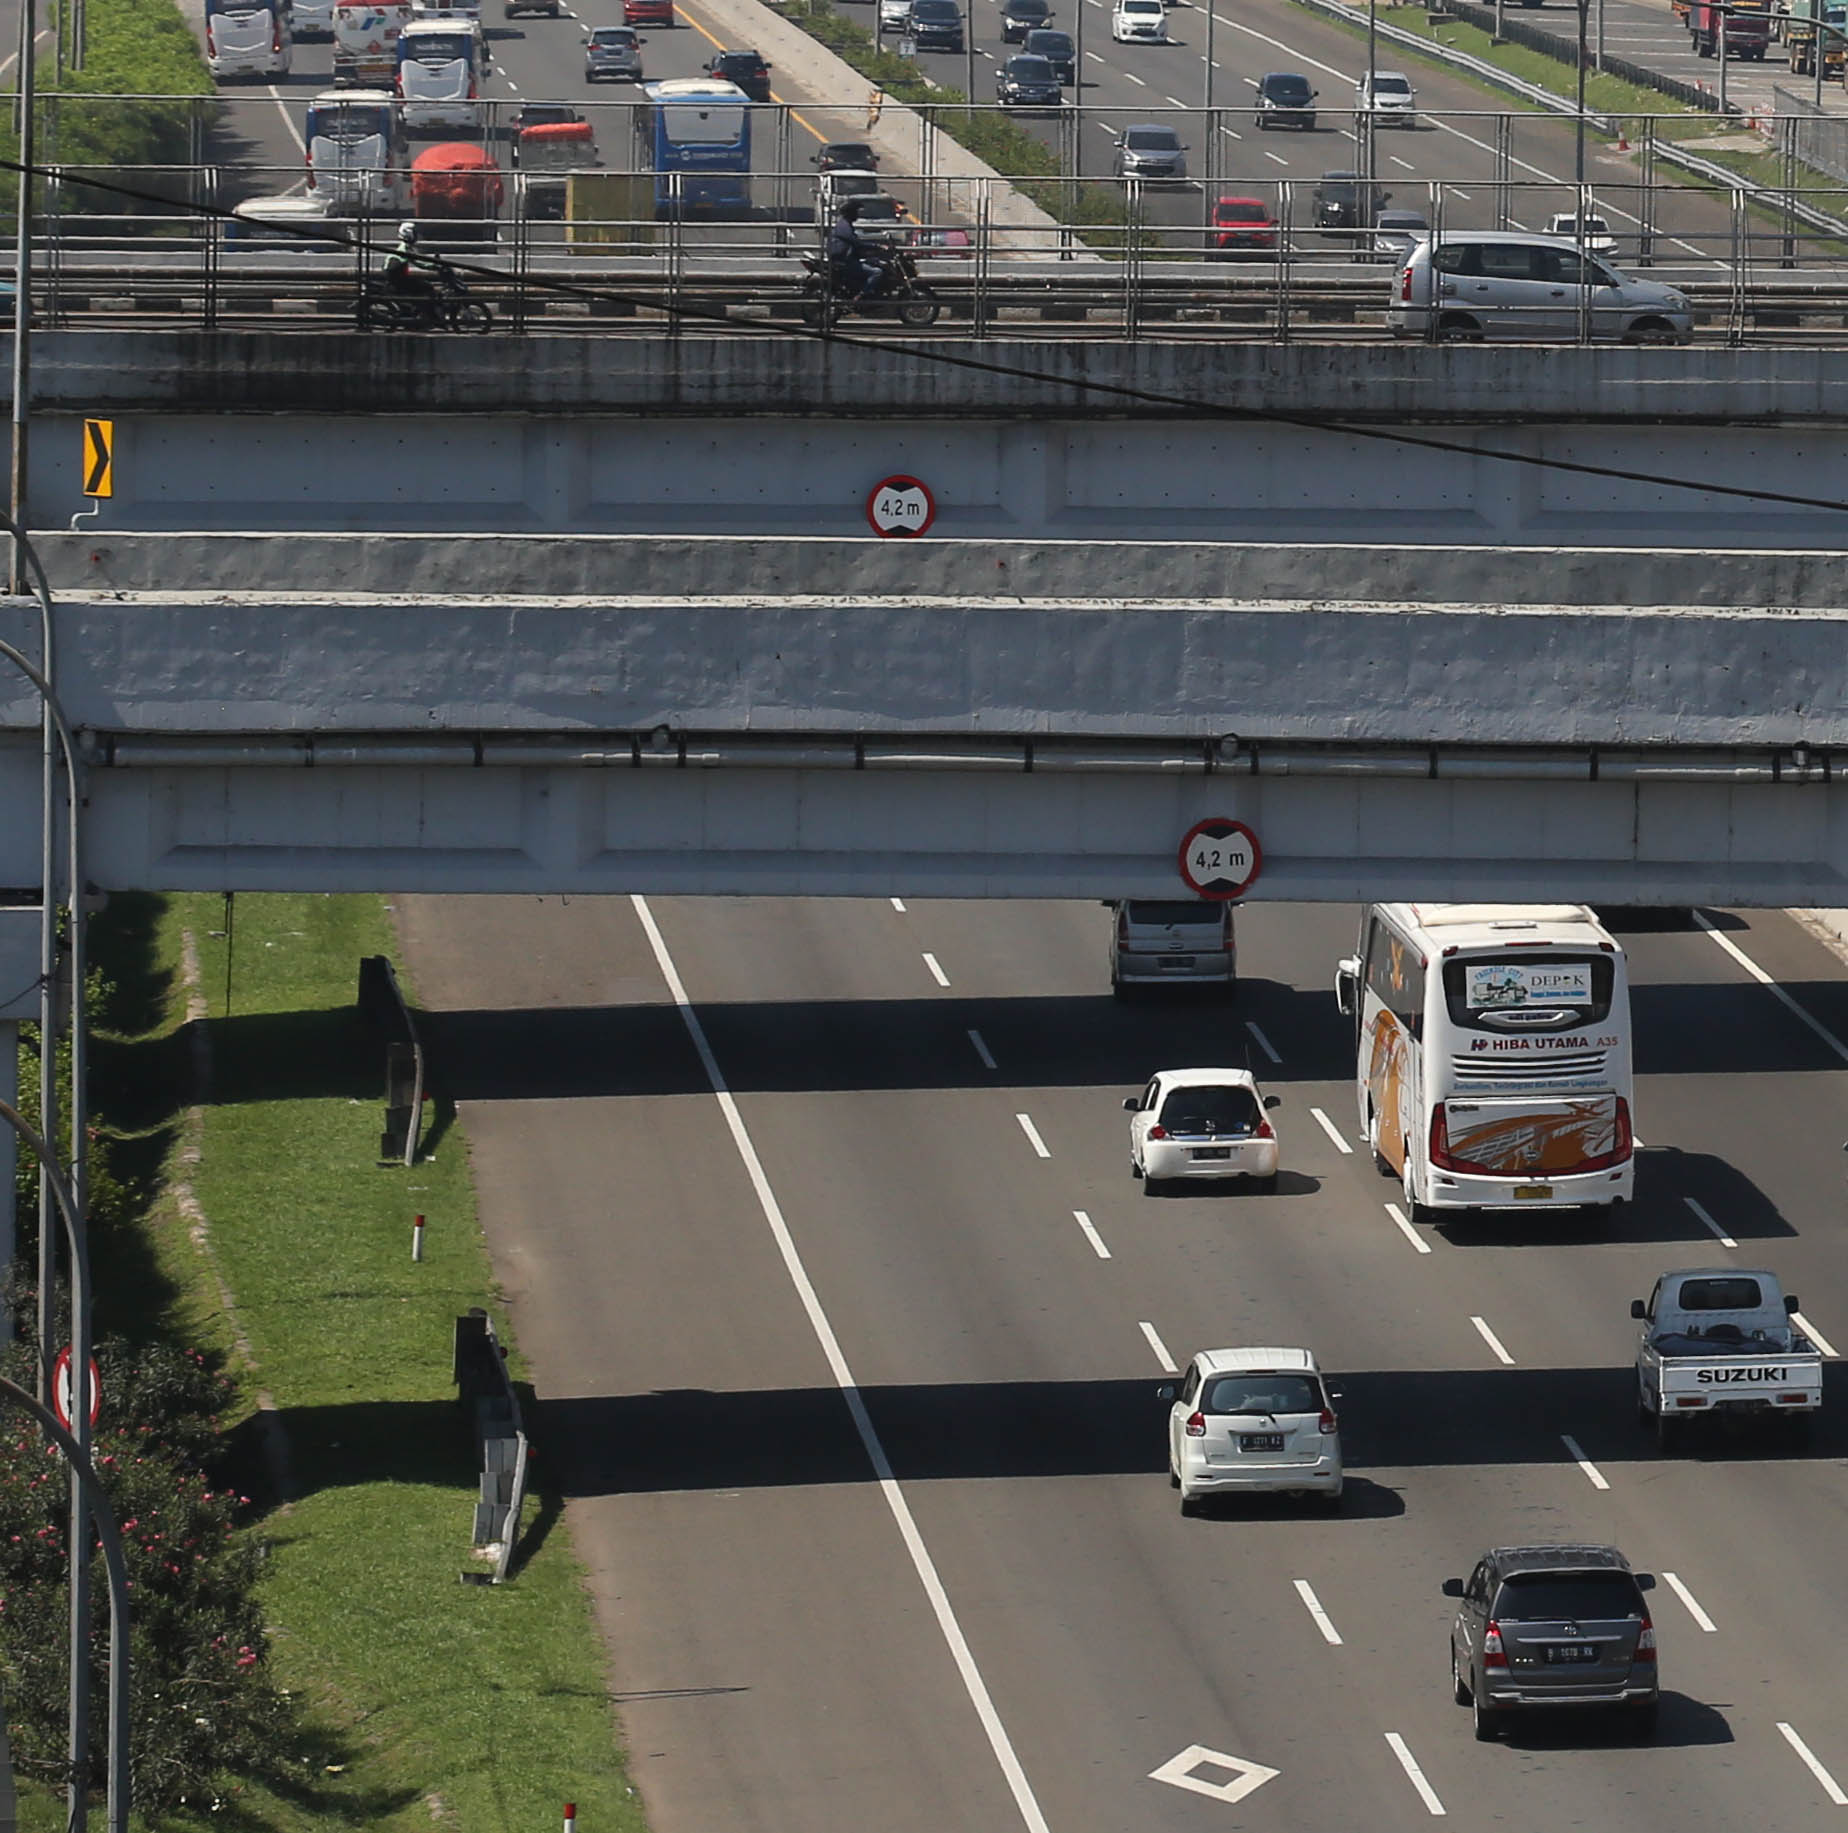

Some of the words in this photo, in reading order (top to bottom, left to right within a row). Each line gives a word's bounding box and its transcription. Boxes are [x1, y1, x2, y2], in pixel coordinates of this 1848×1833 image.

[907, 503, 920, 516] m
[1196, 850, 1221, 870] 4,2
[1229, 852, 1245, 867] m
[1493, 1039, 1530, 1051] HIBA
[1535, 1037, 1589, 1049] UTAMA
[1596, 1037, 1618, 1046] A35
[1697, 1367, 1788, 1384] SUZUKI
